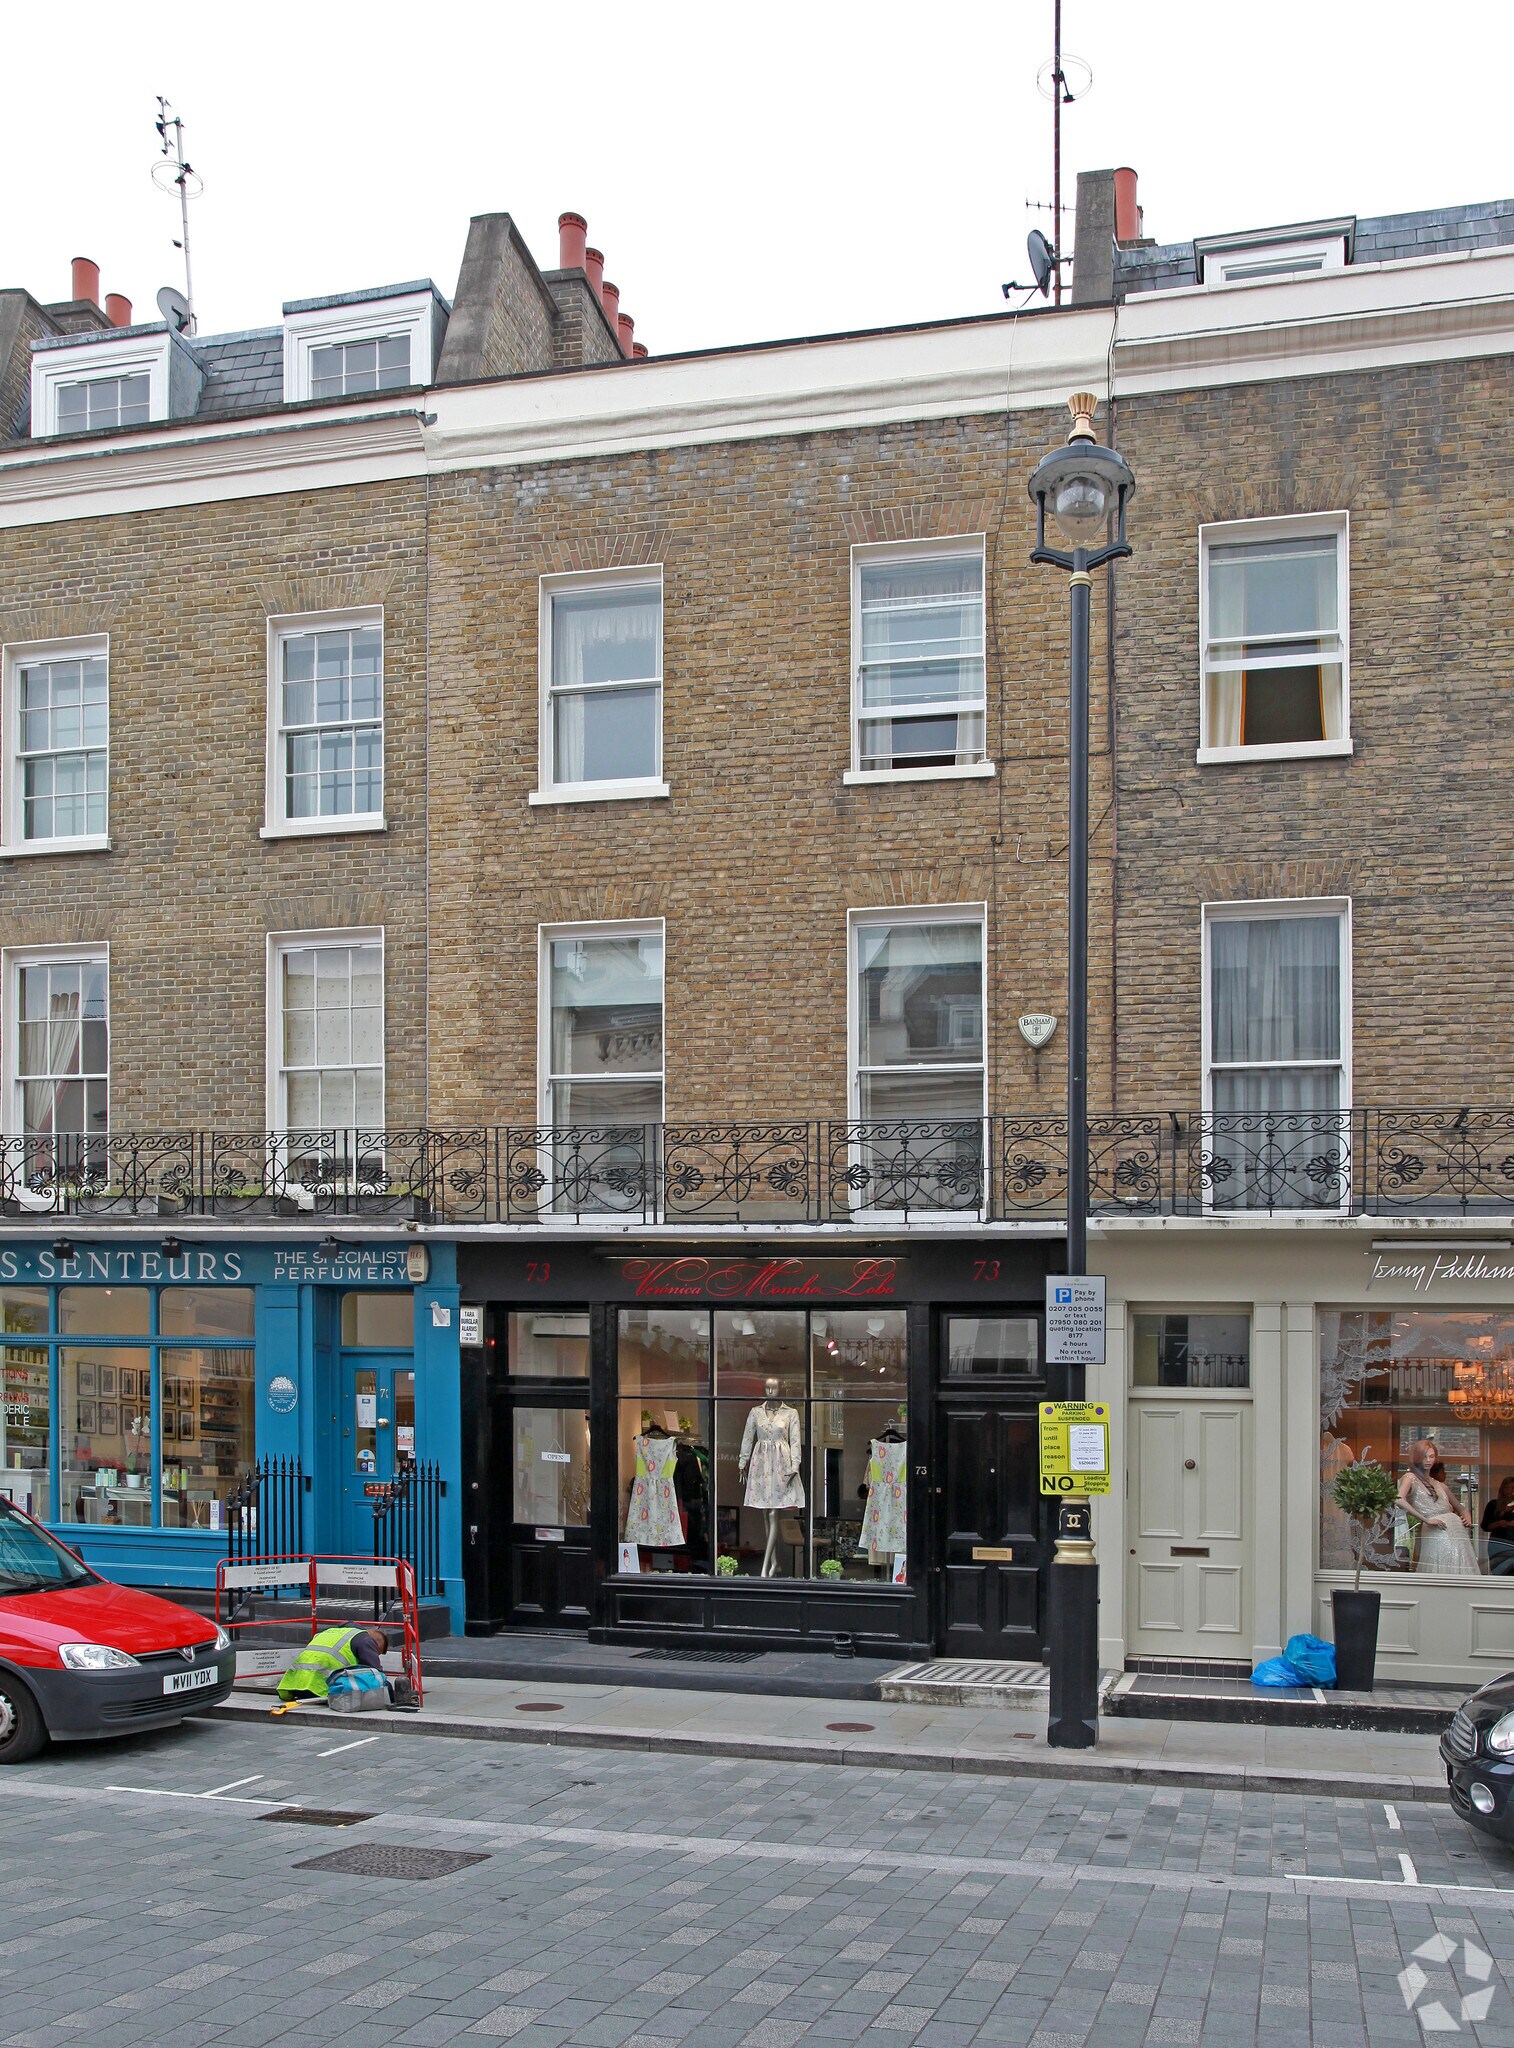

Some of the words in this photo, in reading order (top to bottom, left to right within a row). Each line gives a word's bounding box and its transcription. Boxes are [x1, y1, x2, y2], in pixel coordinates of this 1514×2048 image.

[274, 1251, 307, 1264] THE
[312, 1251, 407, 1264] SECIALIST
[37, 1251, 242, 1281] SENTEURS
[274, 1267, 407, 1280] PERFUMERY
[526, 1262, 551, 1284] 73
[973, 1260, 1001, 1282] 73
[818, 1258, 897, 1297] Lobo
[1059, 1289, 1070, 1303] P
[379, 1388, 389, 1399] 71
[915, 1466, 927, 1475] 73
[1042, 1476, 1074, 1491] NO
[194, 1669, 211, 1686] YDX
